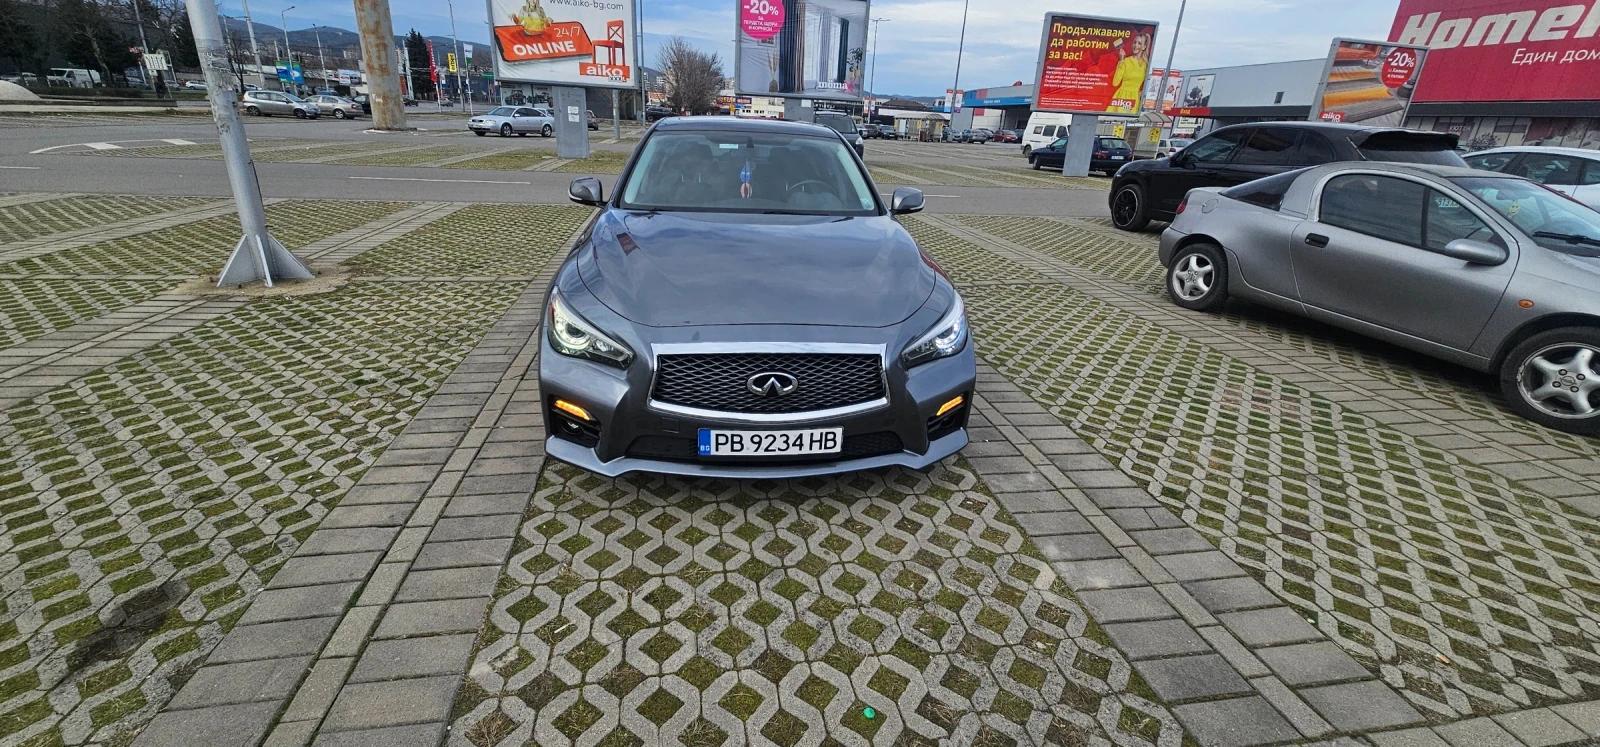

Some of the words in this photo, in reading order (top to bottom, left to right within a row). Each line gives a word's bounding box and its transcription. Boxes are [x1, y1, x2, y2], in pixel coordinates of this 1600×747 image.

[743, 0, 779, 15] -20%
[554, 26, 580, 38] 24/7
[1053, 23, 1131, 38] Продължаваме
[513, 40, 576, 56] ONLINE
[1050, 38, 1064, 47] да
[1066, 38, 1109, 49] работим
[1048, 51, 1060, 59] за
[1063, 51, 1083, 60] вас!
[1388, 52, 1415, 67] -20%
[1511, 48, 1557, 65] Един
[586, 66, 623, 76] aiko
[1111, 99, 1132, 107] aiko
[1322, 112, 1341, 120] aiko
[715, 433, 744, 452] PB
[750, 433, 804, 452] 9234
[809, 431, 837, 451] HB
